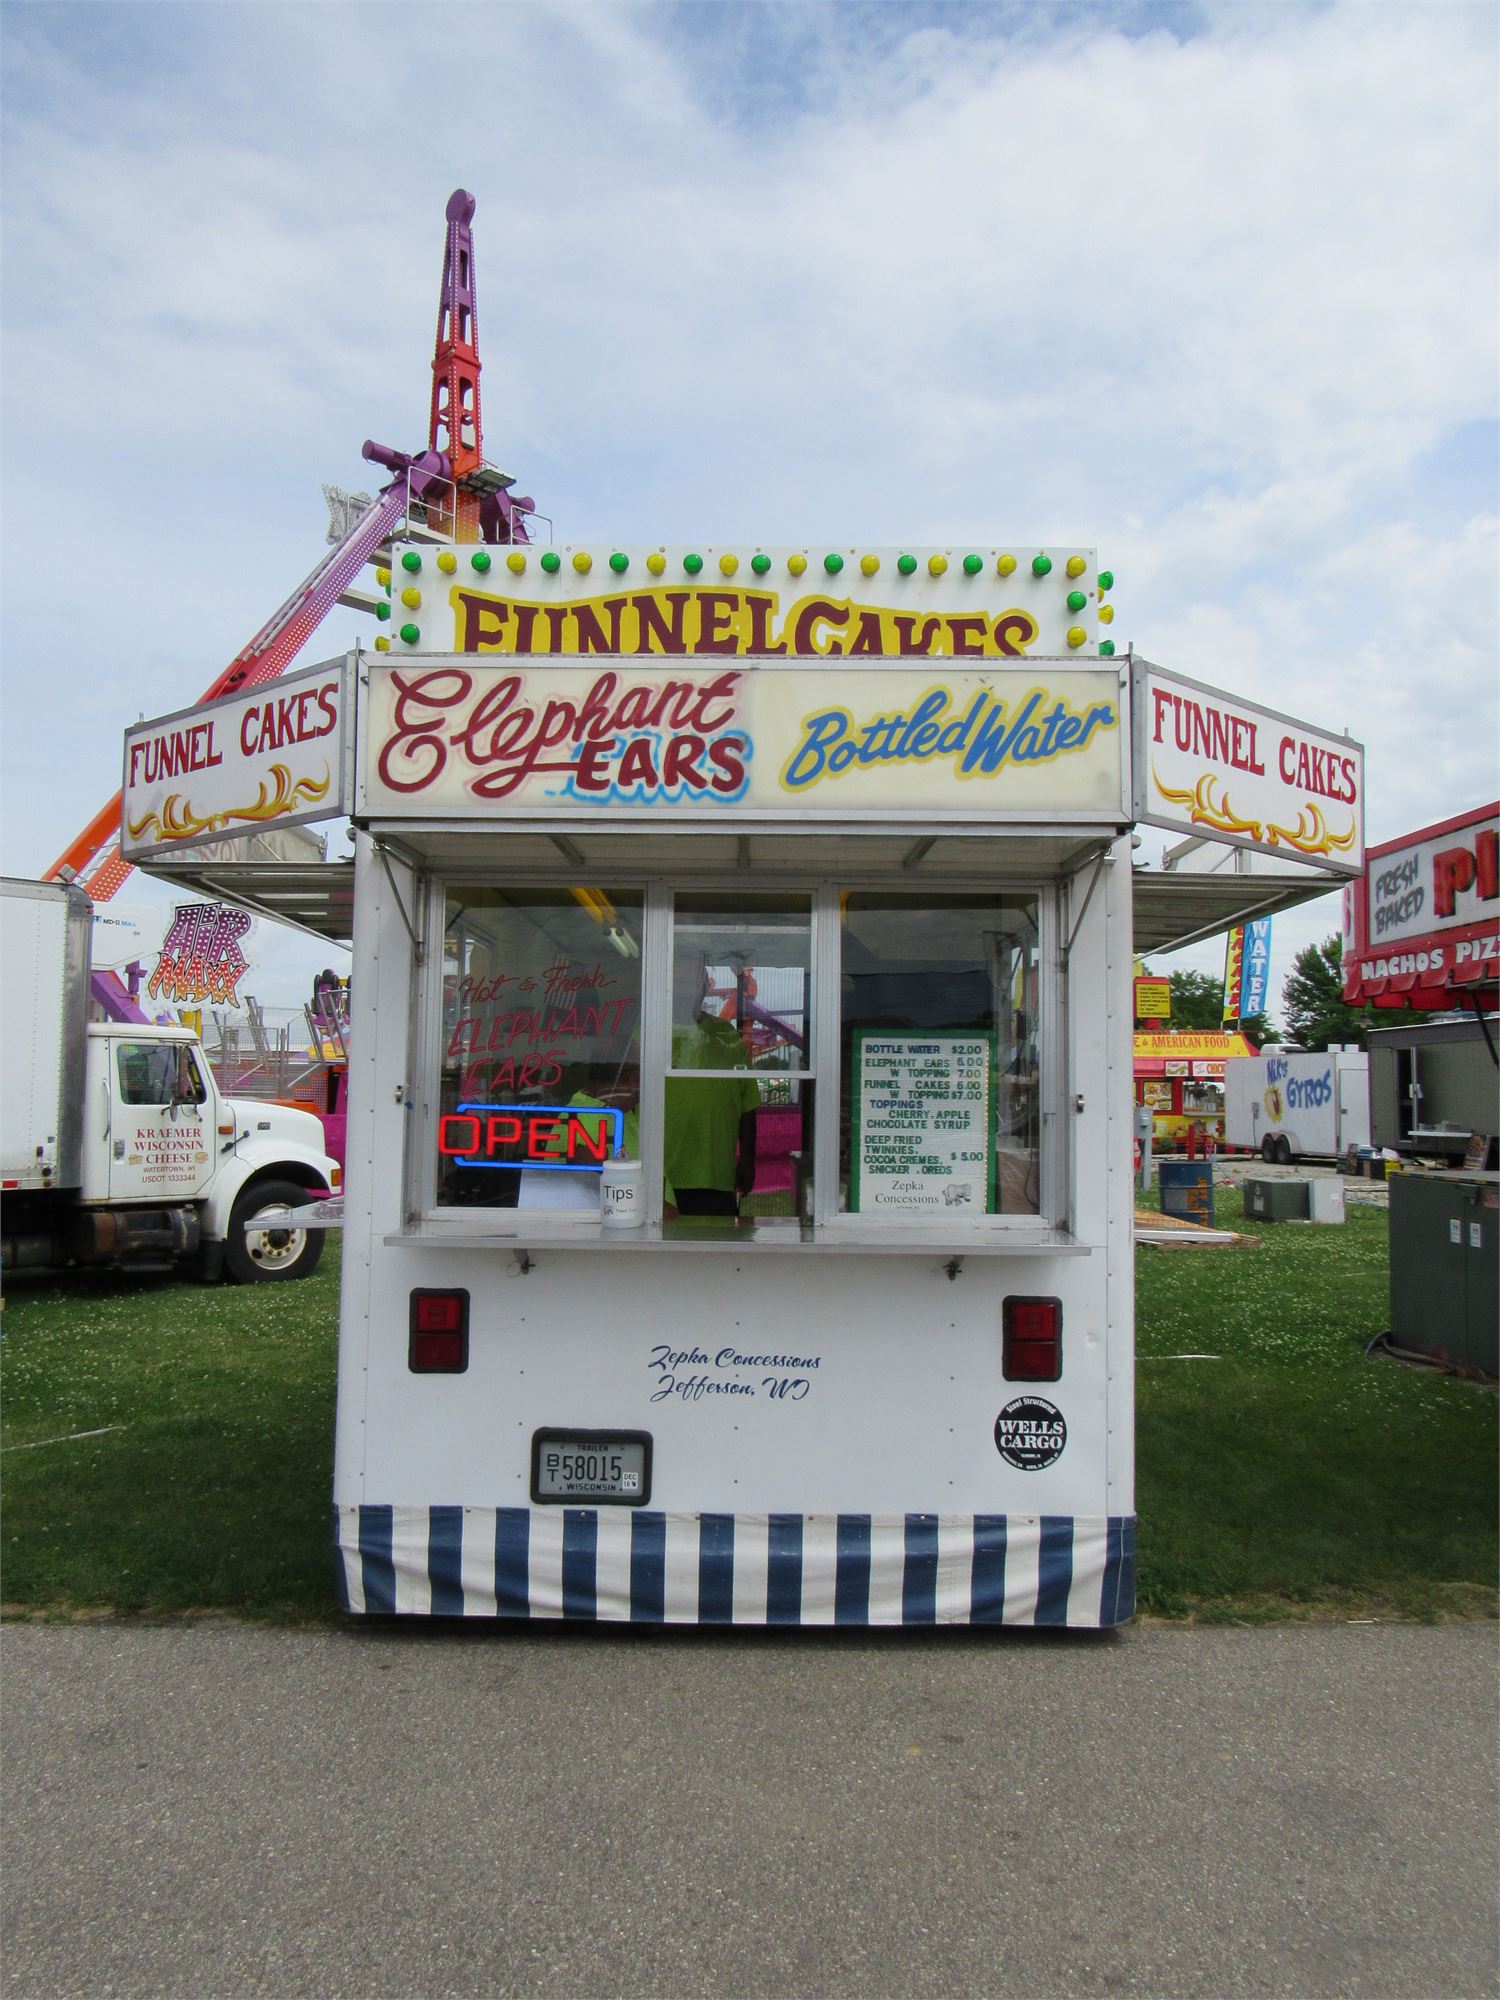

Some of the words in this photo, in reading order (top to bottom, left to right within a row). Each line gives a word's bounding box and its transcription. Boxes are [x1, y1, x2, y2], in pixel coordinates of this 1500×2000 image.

[458, 592, 788, 654] FUNNEL
[794, 601, 1034, 655] CAKES
[129, 721, 223, 788] FUNNEL
[240, 682, 339, 757] CAKES
[378, 668, 743, 799] Elephant
[785, 690, 989, 786] Bottled
[960, 692, 1115, 773] Water
[1151, 686, 1265, 777] FUNNEL
[1278, 735, 1357, 805] CAKES
[575, 734, 745, 793] EARS
[1375, 852, 1419, 904] FRESH
[1374, 885, 1425, 936] BAKED
[1246, 919, 1270, 1012] WATER
[1361, 948, 1444, 981] NACHOS
[148, 951, 250, 1009] MAXX
[457, 974, 521, 1003] Hot
[519, 976, 538, 993] &
[543, 962, 617, 998] Fresh
[447, 998, 637, 1057] ELEPHANT
[865, 1044, 903, 1054] BOTTLE
[908, 1044, 940, 1055] WATER
[951, 1045, 982, 1055] $2.00
[1151, 1036, 1202, 1048] AMERICAN
[1205, 1036, 1230, 1049] FOOD
[865, 1058, 917, 1068] ELEPHANT
[924, 1059, 950, 1068] EARS
[459, 1049, 567, 1097] EARS
[890, 1068, 900, 1078] W
[908, 1068, 950, 1078] TOPPING
[957, 1069, 981, 1079] 7.00
[864, 1080, 901, 1089] FUNNEL
[915, 1080, 950, 1090] CAKES
[957, 1081, 981, 1090] 6.00
[1286, 1069, 1332, 1109] GYROS
[890, 1090, 900, 1099] W
[908, 1090, 949, 1100] TOPPING
[951, 1090, 982, 1100] $7.00
[869, 1099, 924, 1109] TOPPINGS
[137, 1128, 200, 1137] KRAEMER
[866, 1119, 928, 1129] CHOCOLATE
[934, 1120, 971, 1130] SYRUP
[438, 1113, 608, 1160] OPEN
[864, 1135, 891, 1145] DEEP
[893, 1135, 923, 1145] FRIED
[134, 1140, 203, 1150] WISCONSIN
[146, 1153, 192, 1162] CHEESE
[863, 1155, 897, 1165] COCOA
[868, 1165, 910, 1174] SNICKER
[603, 1185, 634, 1203] Tips
[891, 1180, 924, 1193] Zepka
[875, 1192, 939, 1204] Concessions
[648, 1344, 711, 1370] Zepka
[715, 1347, 822, 1370] Concessions
[999, 1419, 1064, 1435] WELLS
[577, 1444, 609, 1452] TRAILER
[1000, 1434, 1063, 1450] CARGO
[562, 1455, 623, 1482] 58015
[566, 1482, 617, 1492] WISCONSIN
